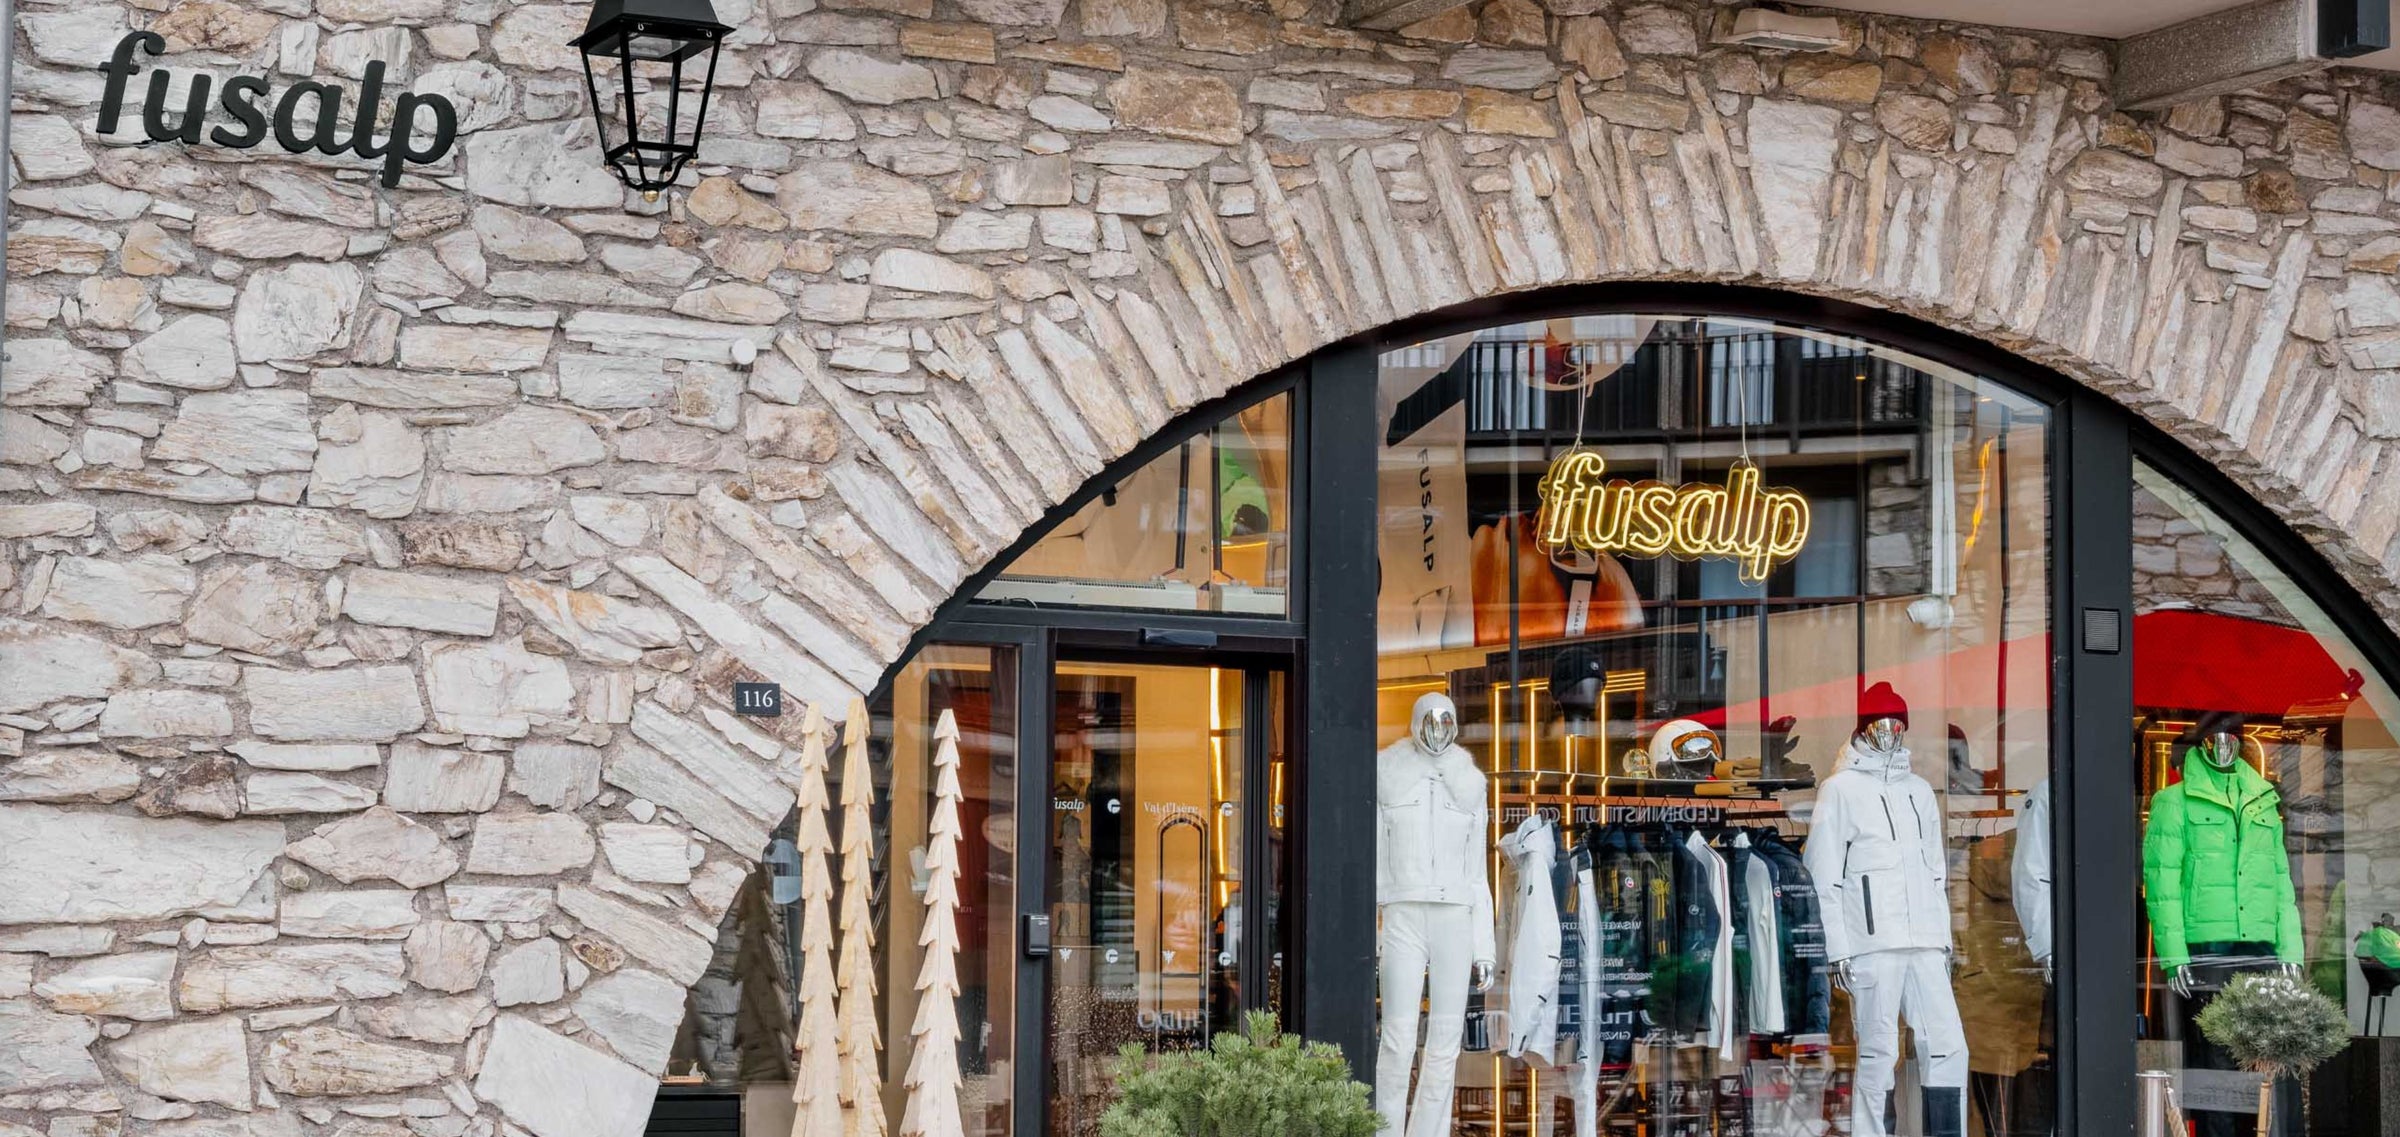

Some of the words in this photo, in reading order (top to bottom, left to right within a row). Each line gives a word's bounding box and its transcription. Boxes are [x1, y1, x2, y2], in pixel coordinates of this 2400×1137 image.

[96, 31, 458, 189] fusalp
[1417, 448, 1434, 572] FUSALP
[1546, 451, 1810, 581] fusalp
[743, 689, 774, 708] 116
[1053, 797, 1086, 813] usalp
